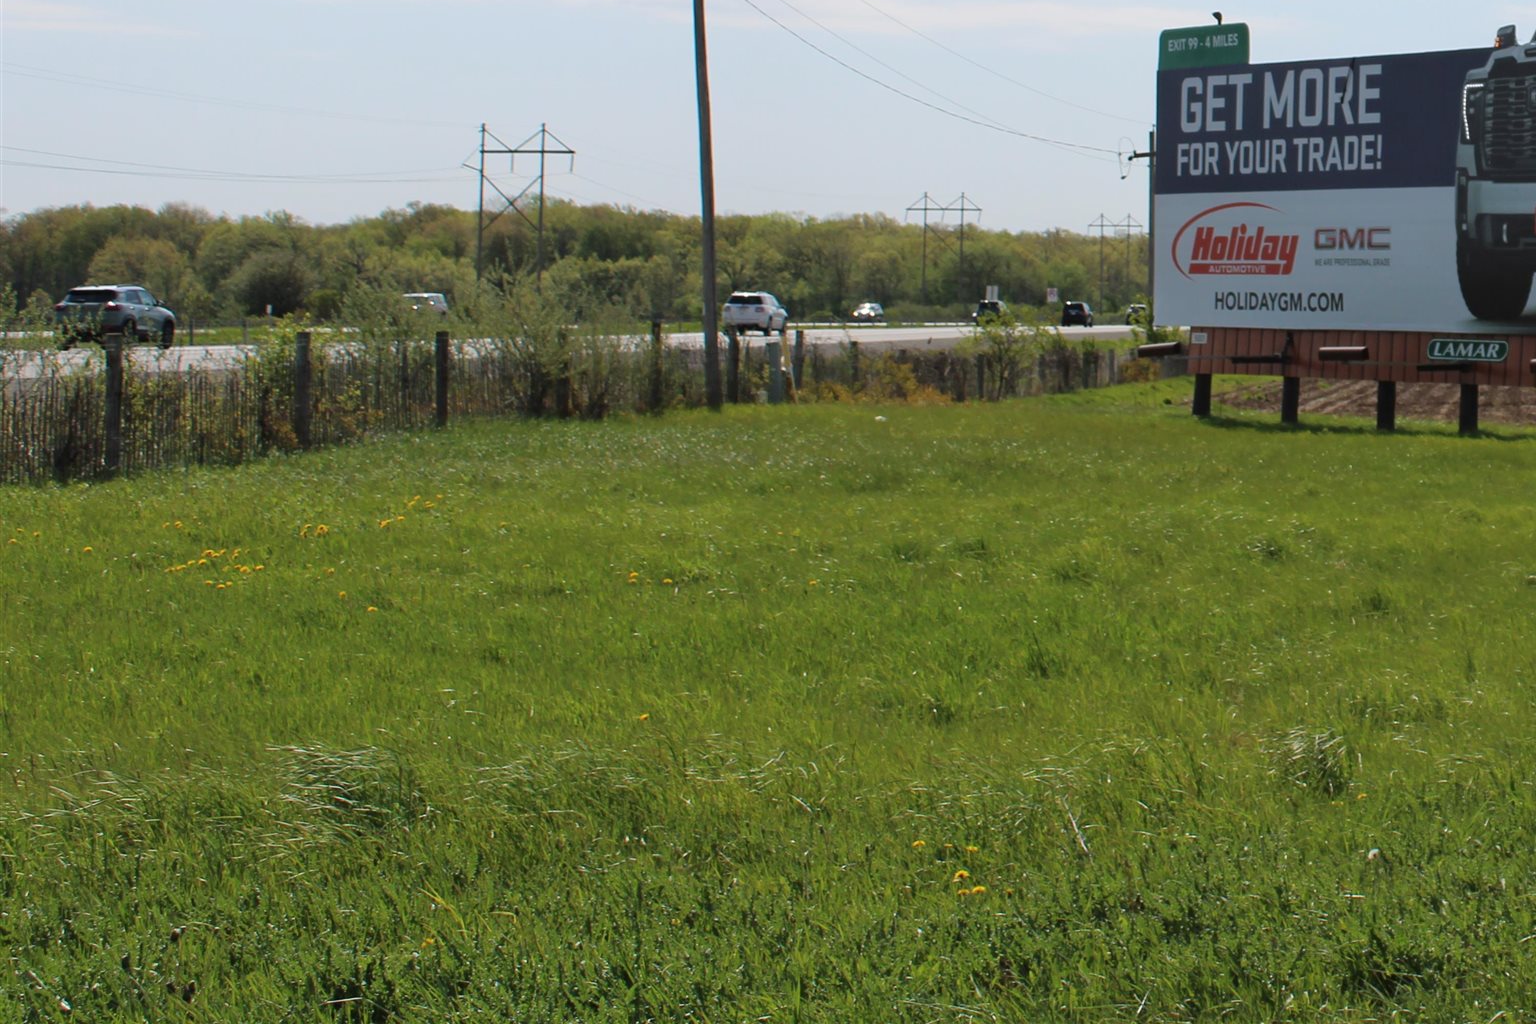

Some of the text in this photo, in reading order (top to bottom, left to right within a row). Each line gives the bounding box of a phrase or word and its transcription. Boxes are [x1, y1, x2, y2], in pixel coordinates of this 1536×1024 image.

[1168, 38, 1186, 52] EXIT
[1188, 37, 1199, 50] 99
[1205, 36, 1211, 48] 4
[1212, 33, 1239, 48] MILES
[1180, 64, 1383, 133] GET MORE
[1177, 134, 1383, 176] FOR YOUR TRADE!
[1190, 223, 1299, 276] Holiday
[1314, 228, 1392, 250] GMC
[1208, 264, 1267, 274] AUTOMOTIVE
[1214, 291, 1344, 313] HOLIDAYGM.COM
[1433, 342, 1500, 358] LAMAR
